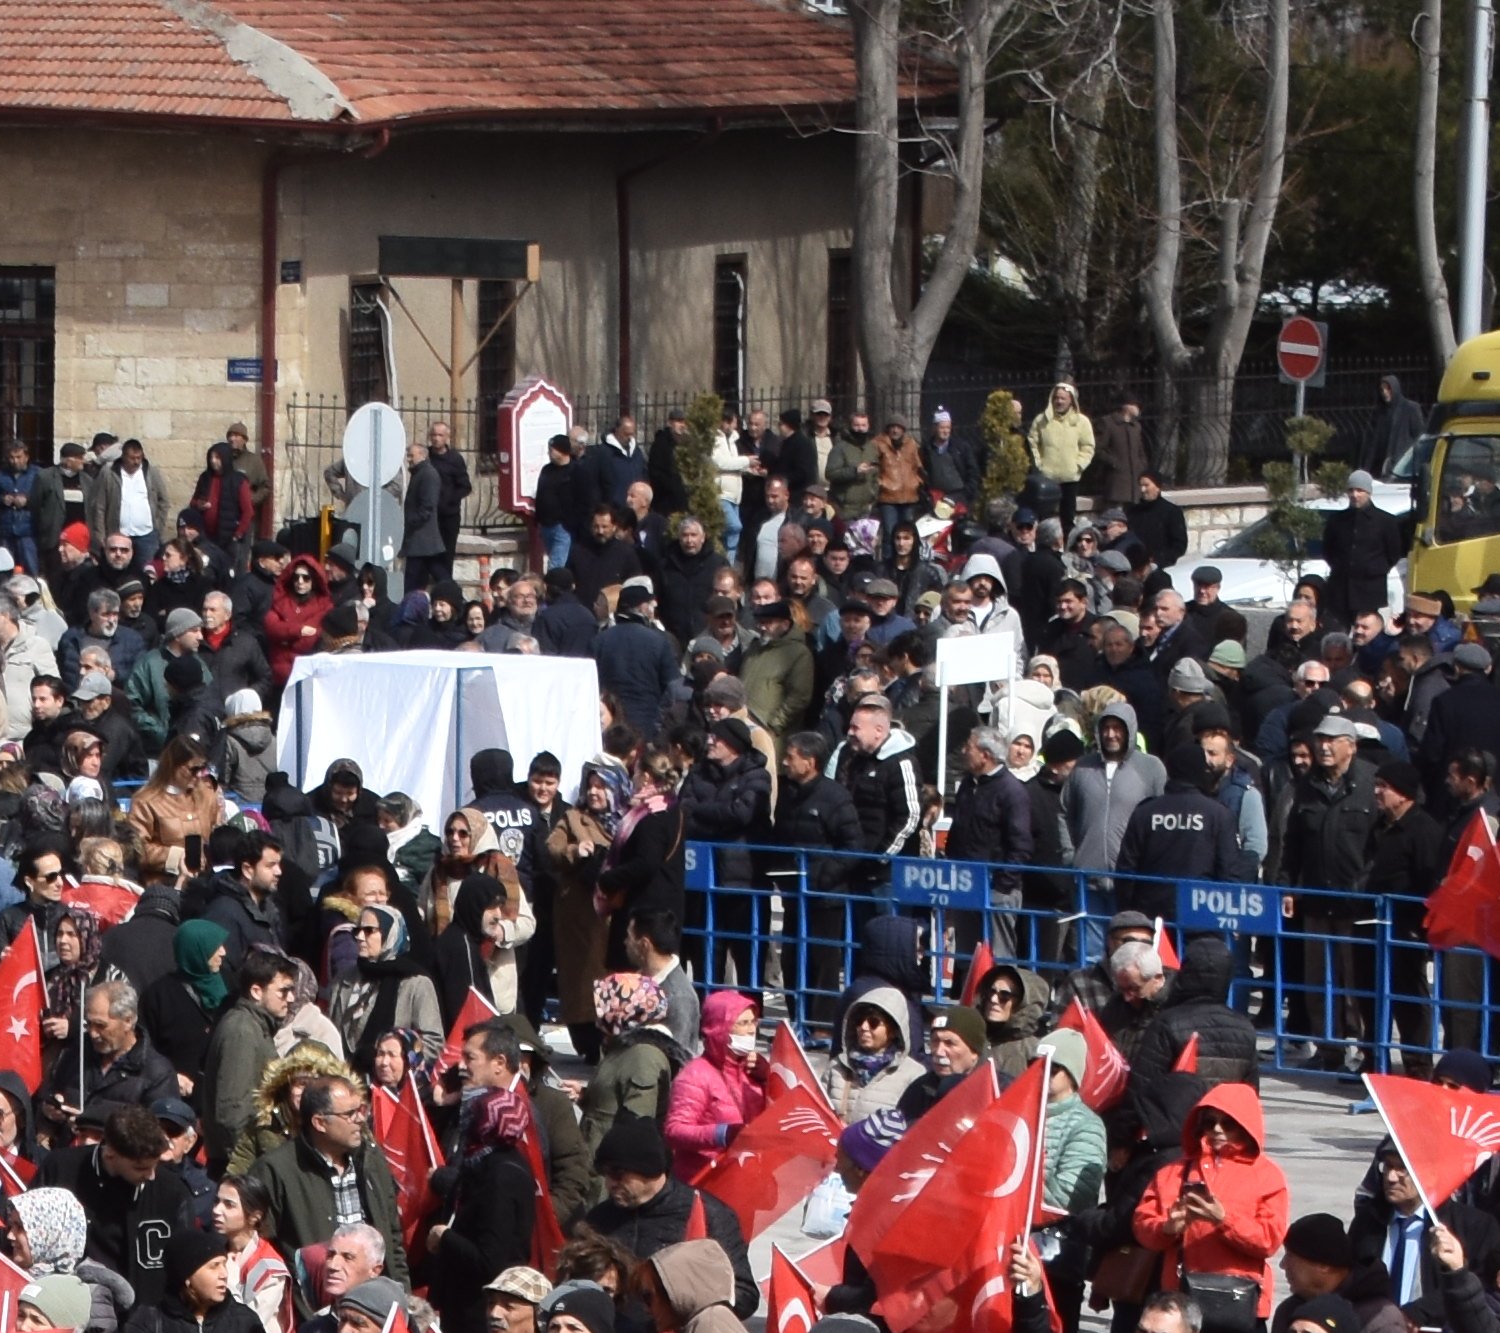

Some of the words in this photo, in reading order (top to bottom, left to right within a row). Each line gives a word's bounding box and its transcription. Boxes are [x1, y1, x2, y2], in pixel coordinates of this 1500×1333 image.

[1151, 813, 1204, 832] POLİS
[903, 864, 973, 892] POLİS
[928, 892, 949, 906] 70
[1191, 887, 1264, 918] POLİS
[136, 1219, 172, 1270] C
